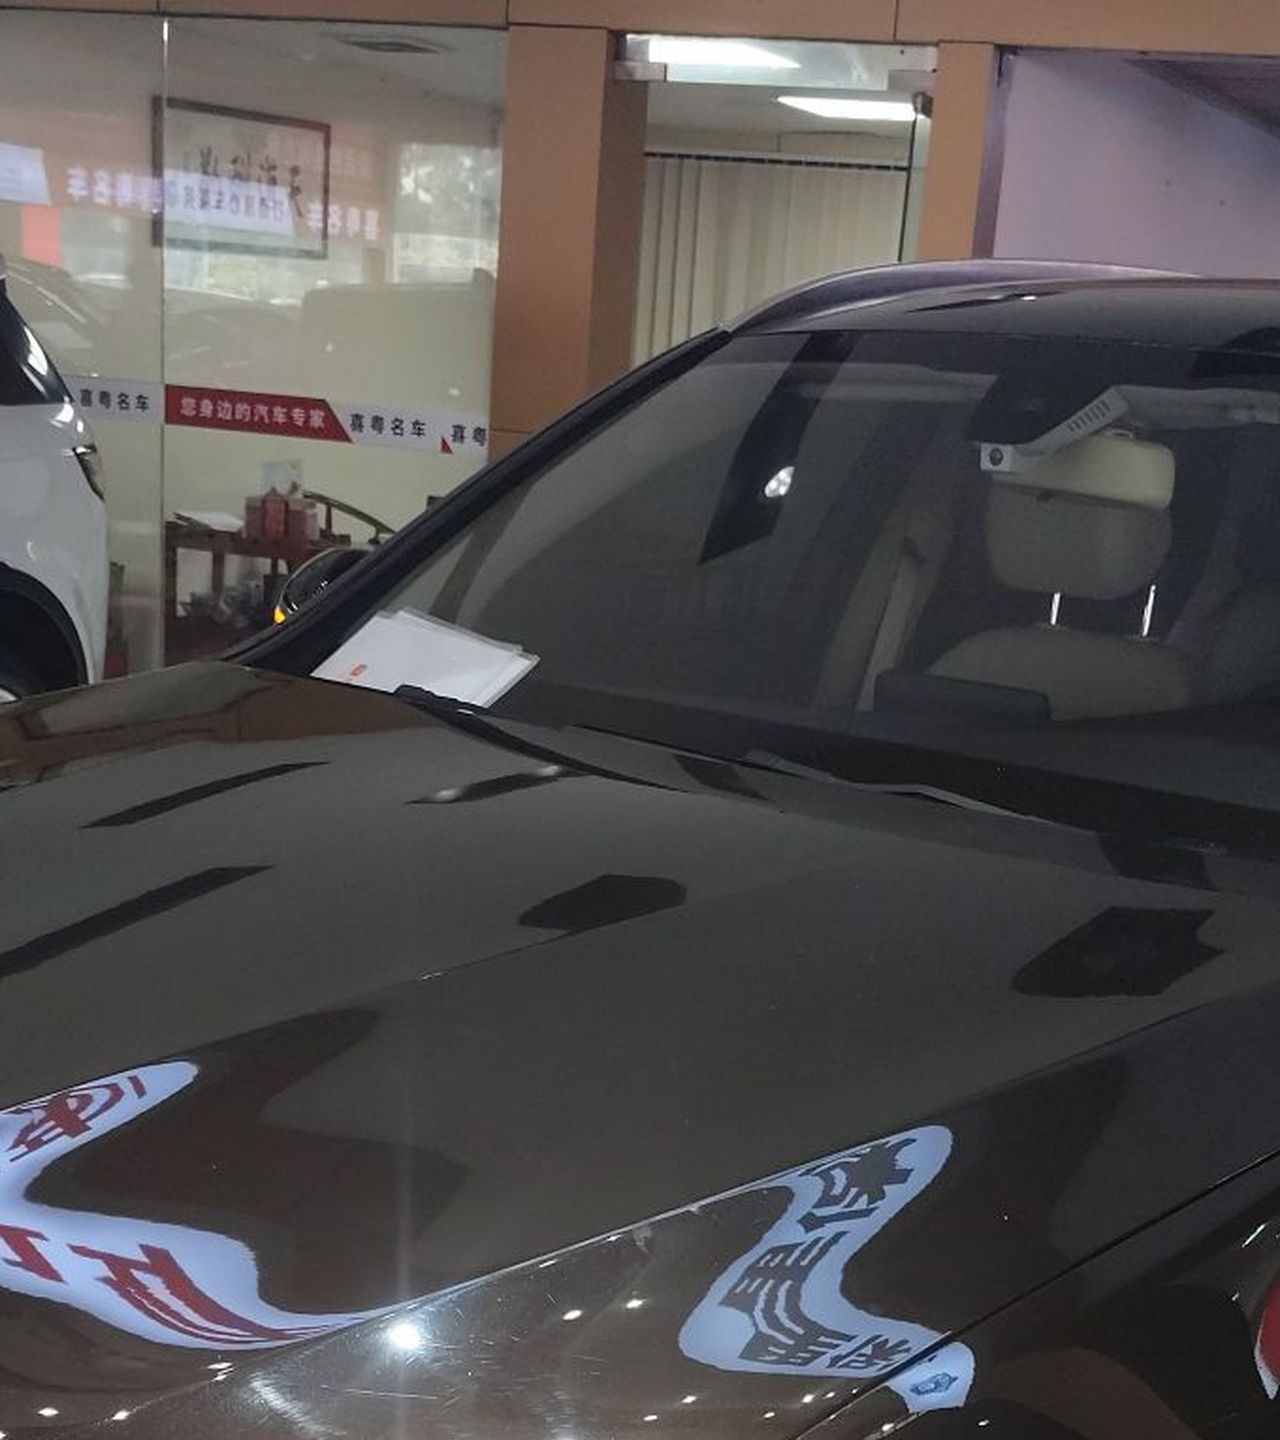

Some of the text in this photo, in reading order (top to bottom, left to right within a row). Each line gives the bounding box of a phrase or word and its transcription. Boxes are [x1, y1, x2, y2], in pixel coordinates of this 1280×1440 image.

[180, 397, 326, 430] 您身边的汽车专家
